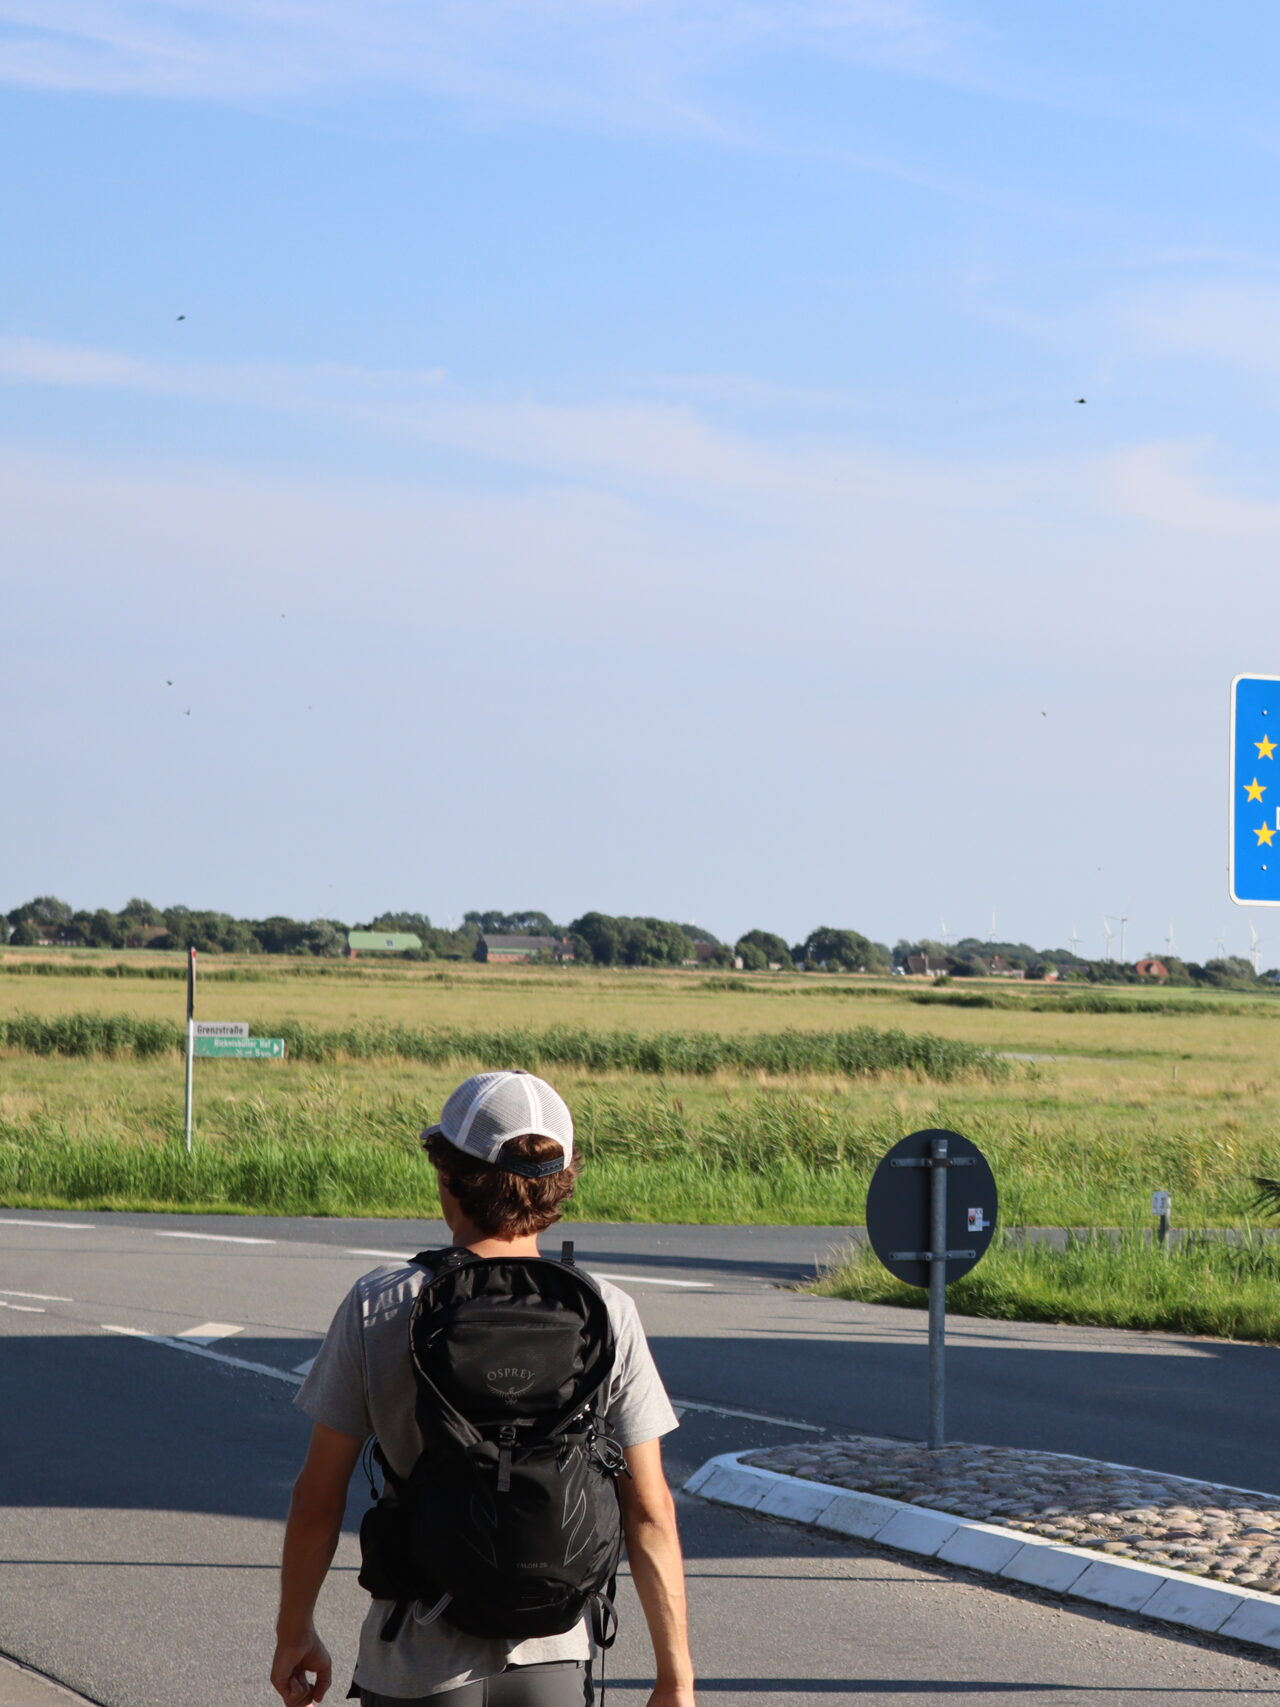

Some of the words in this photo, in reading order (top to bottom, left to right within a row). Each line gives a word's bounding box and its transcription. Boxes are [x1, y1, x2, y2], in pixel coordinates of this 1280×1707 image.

[197, 1024, 243, 1034] Grenzstraße
[487, 1367, 535, 1381] OSPREY
[515, 1561, 538, 1569] TALON
